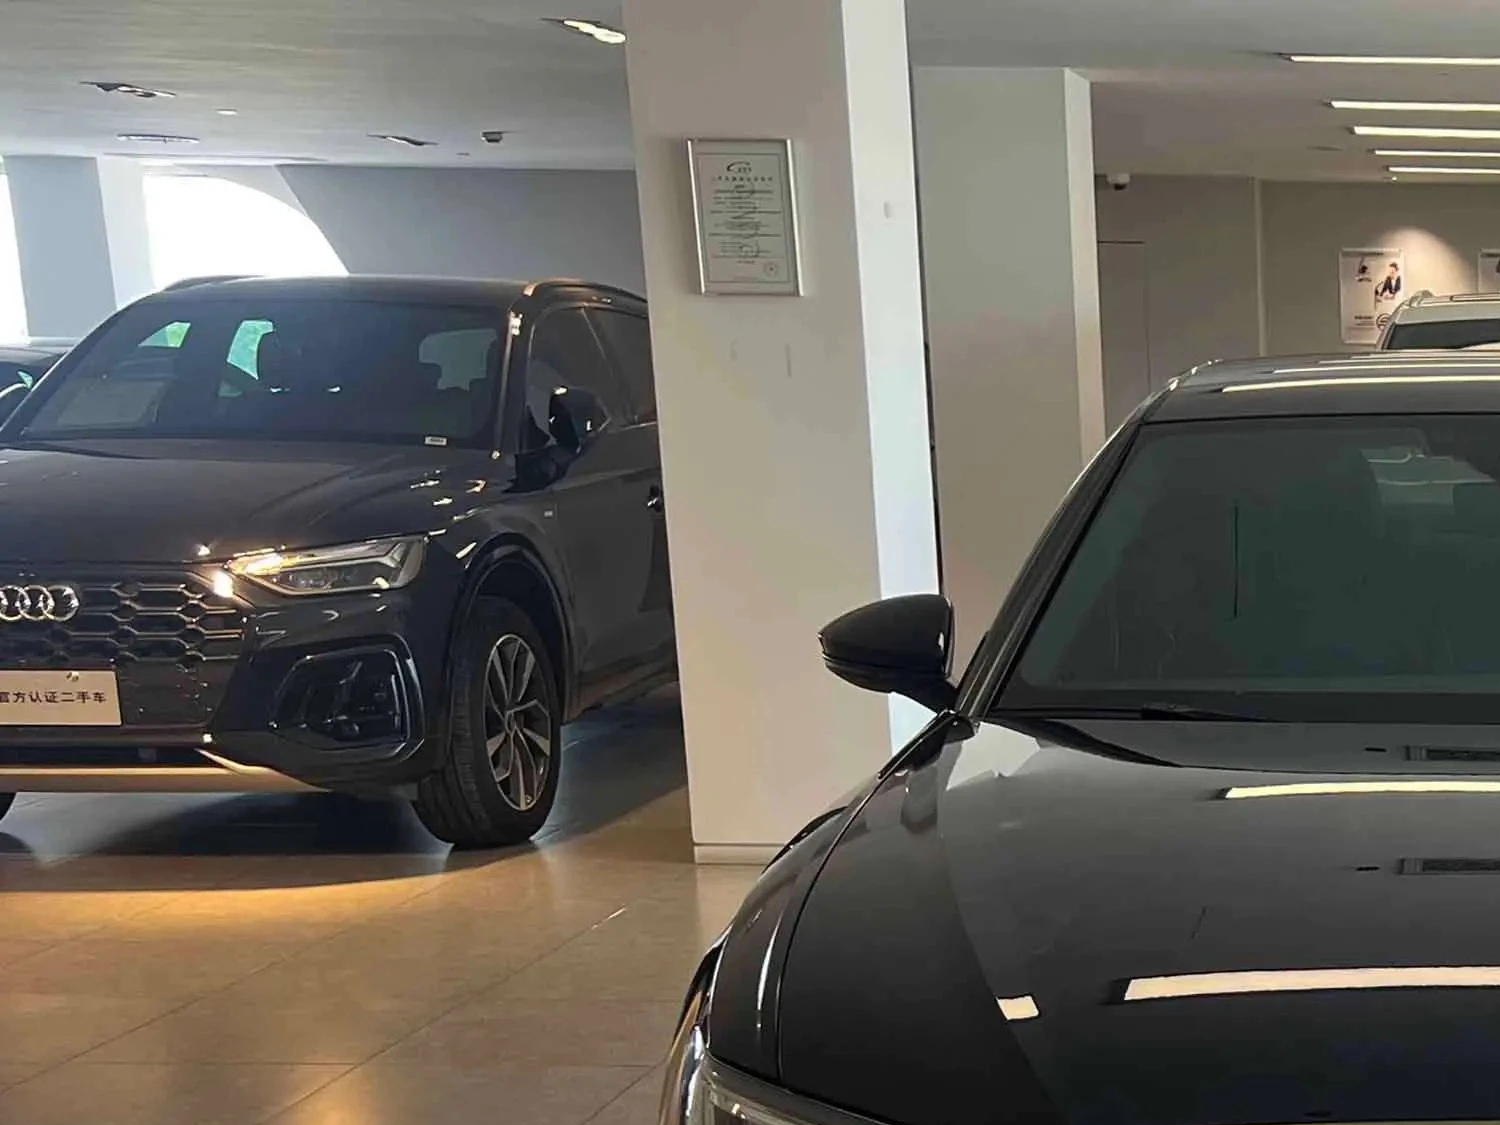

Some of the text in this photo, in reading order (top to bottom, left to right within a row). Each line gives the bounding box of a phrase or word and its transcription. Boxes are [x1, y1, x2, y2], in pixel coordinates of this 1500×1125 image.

[0, 691, 108, 703] 官方认证二手车
